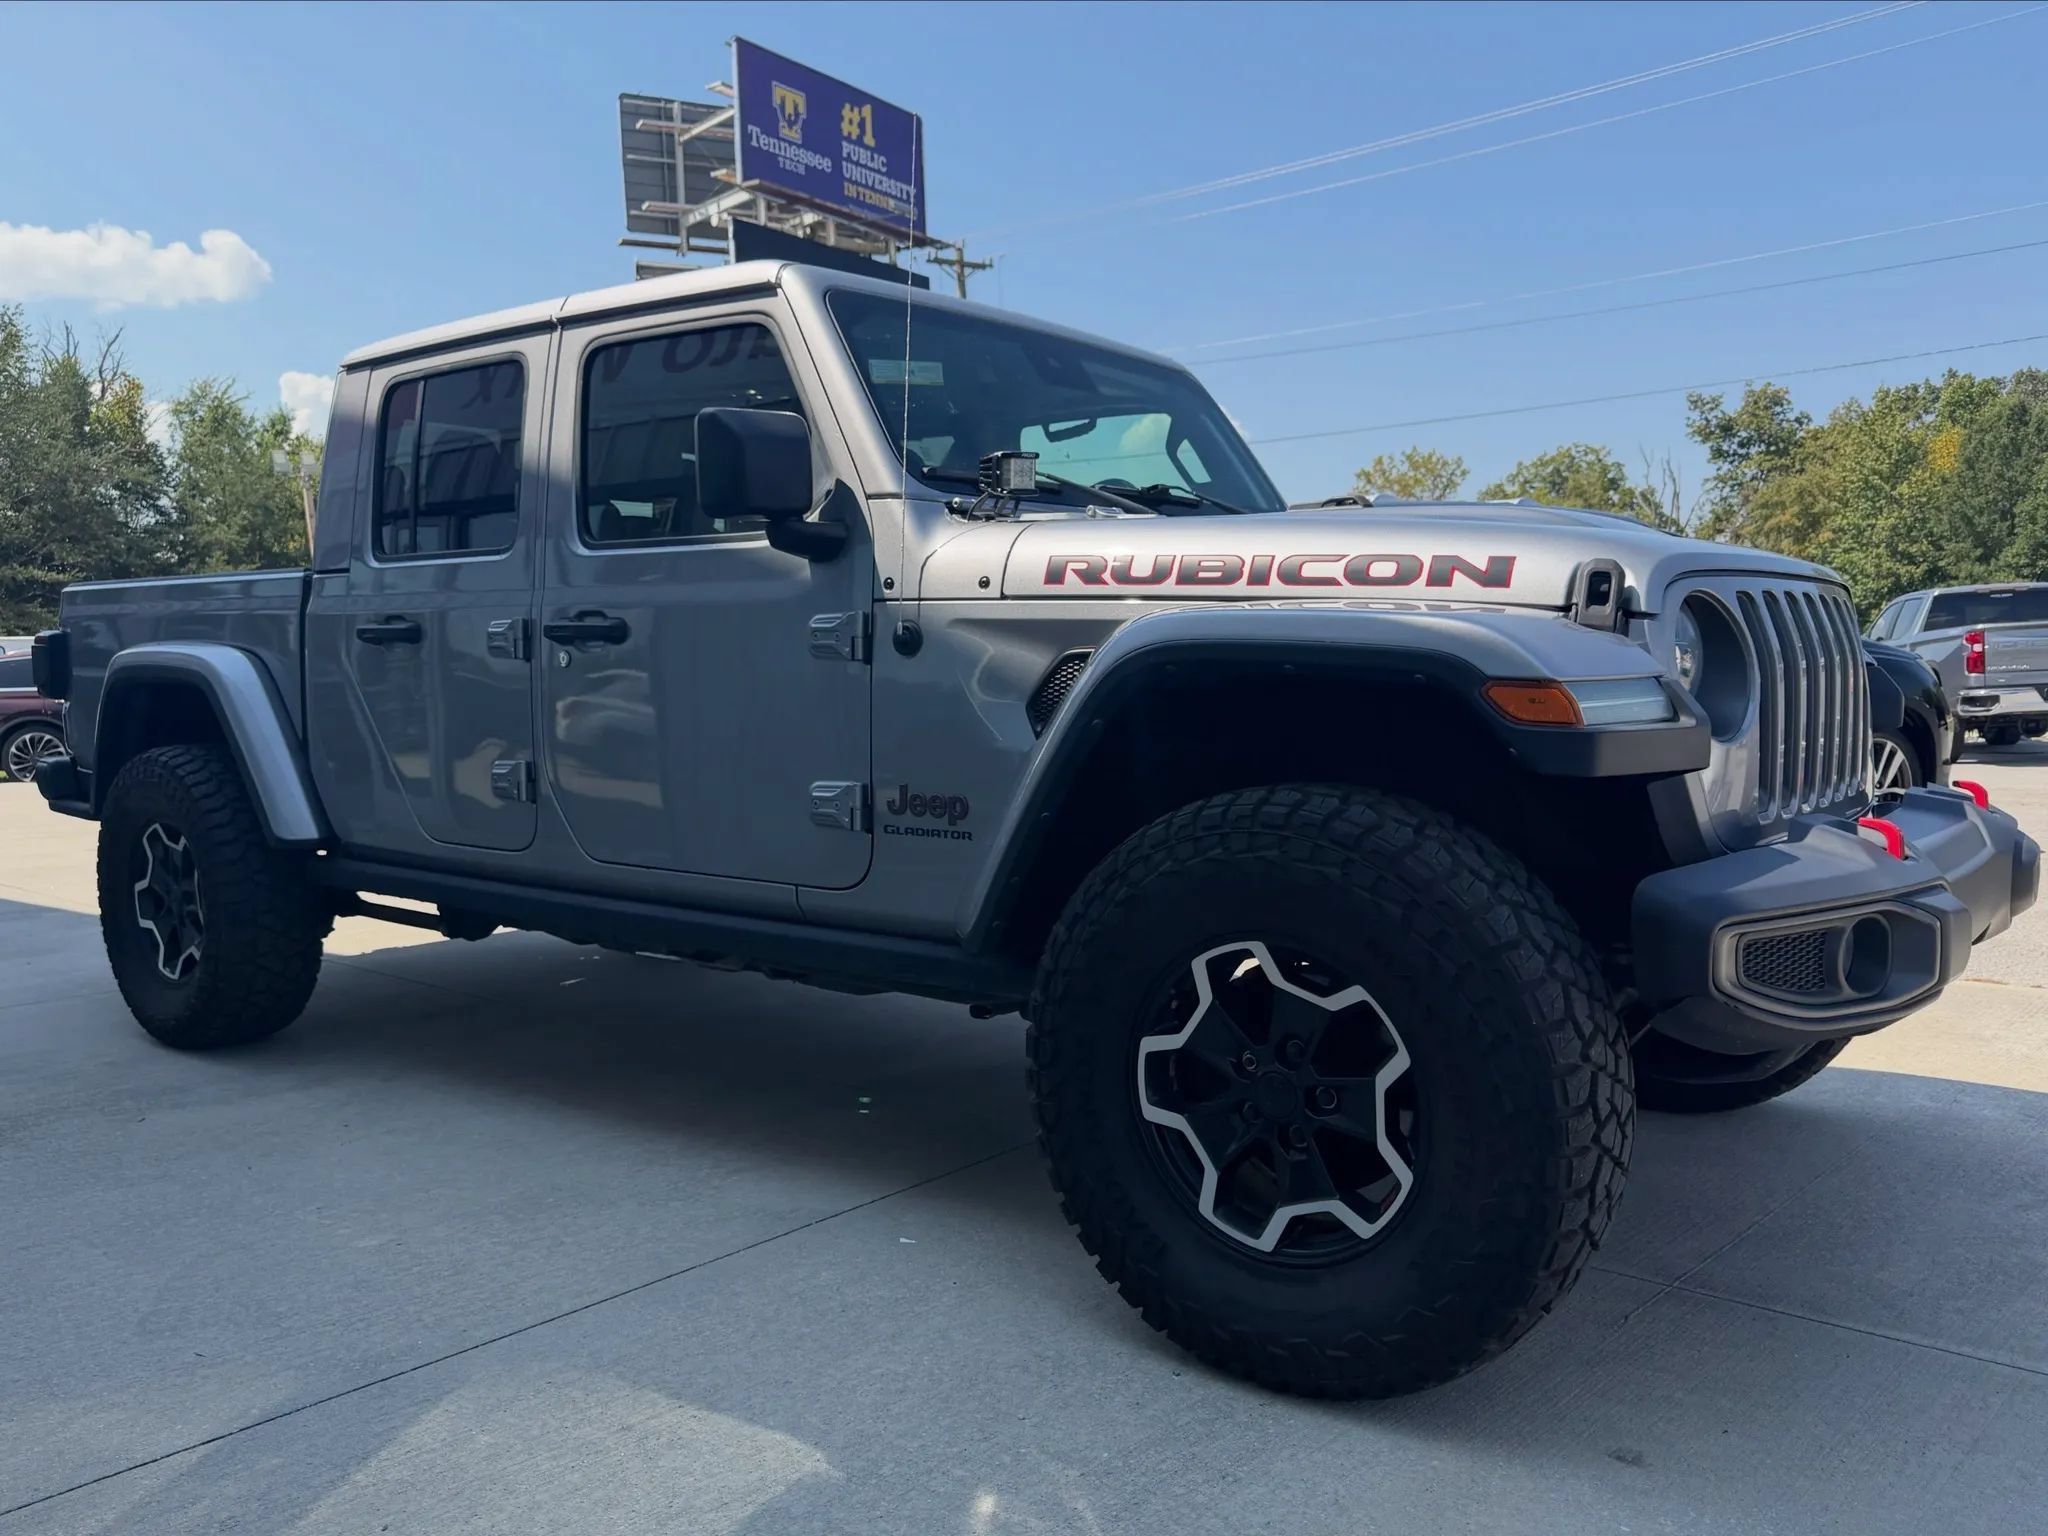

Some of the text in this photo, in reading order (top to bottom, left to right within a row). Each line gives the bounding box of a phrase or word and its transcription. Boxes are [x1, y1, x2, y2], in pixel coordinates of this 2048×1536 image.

[840, 102, 876, 147] #1
[747, 124, 832, 172] Tennessee
[777, 156, 805, 175] TECH
[841, 141, 887, 172] PUBLIC
[842, 160, 916, 202] UNIVERSITY
[1043, 554, 1517, 589] RUBICON
[887, 783, 970, 826] Jeep
[883, 824, 973, 841] GLADIATOR
